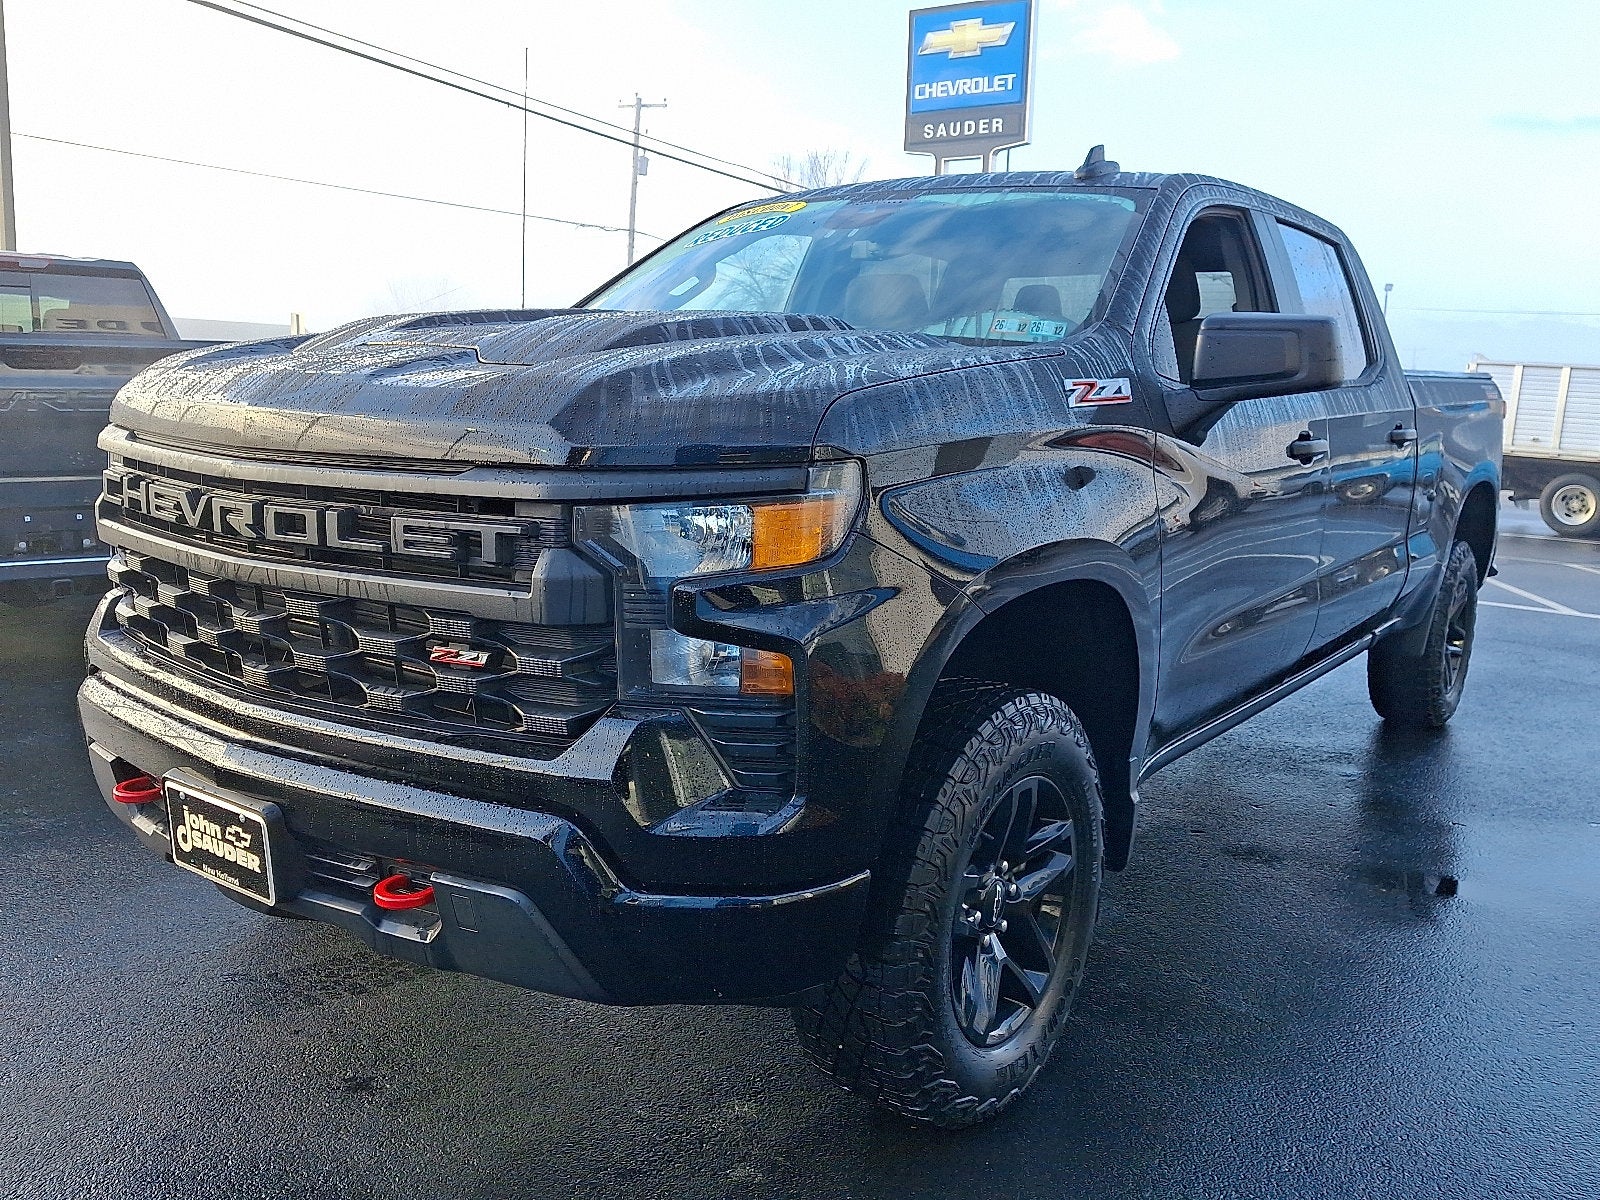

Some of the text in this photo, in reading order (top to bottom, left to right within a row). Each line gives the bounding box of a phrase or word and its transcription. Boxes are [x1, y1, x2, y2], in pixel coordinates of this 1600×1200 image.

[914, 73, 1017, 100] CHEVROLET
[923, 118, 1004, 139] SAUDER
[690, 214, 790, 245] REDUCED
[994, 319, 1027, 332] 26 12
[1030, 321, 1064, 335] 26 12
[103, 469, 525, 564] CHEVROLET
[191, 830, 261, 873] SAUDER
